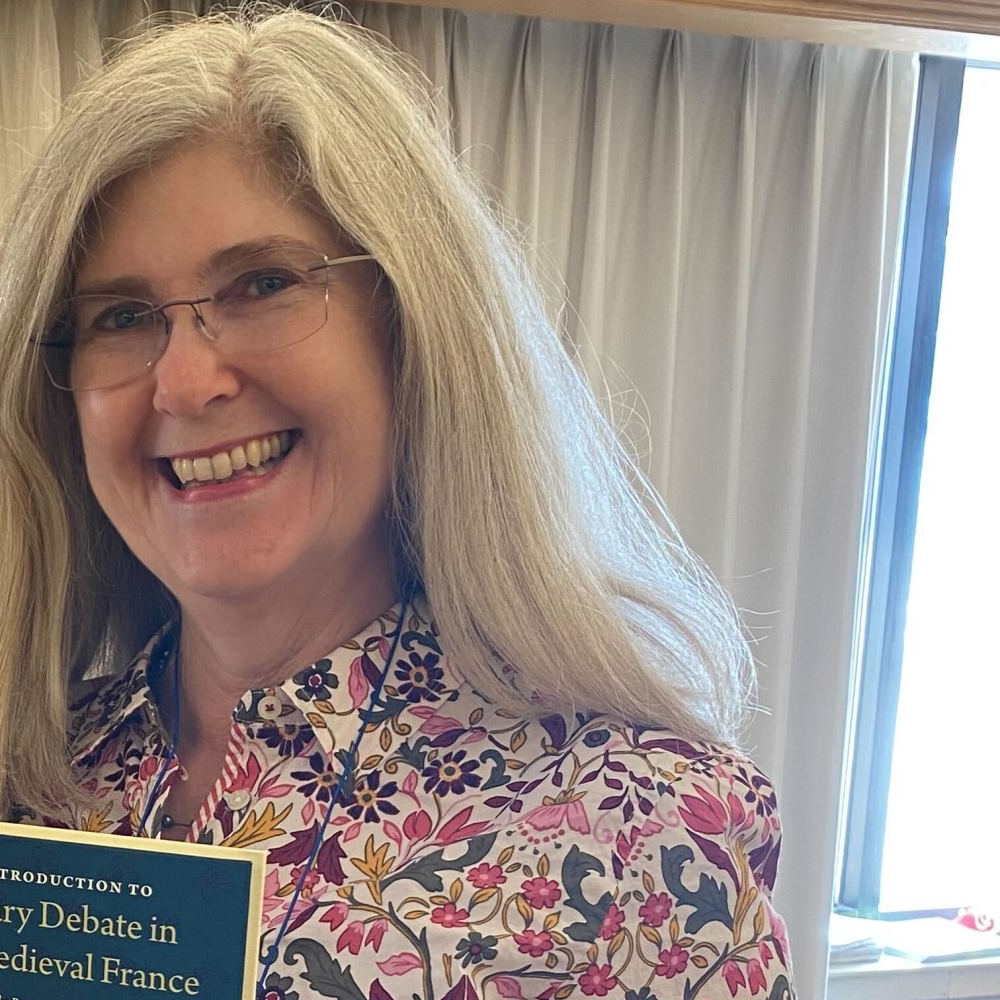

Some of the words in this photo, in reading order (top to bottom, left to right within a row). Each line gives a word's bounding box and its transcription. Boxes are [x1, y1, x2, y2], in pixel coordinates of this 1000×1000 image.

[129, 884, 152, 897] TO
[38, 901, 142, 940] Debate
[149, 916, 178, 945] in
[100, 955, 200, 995] France
